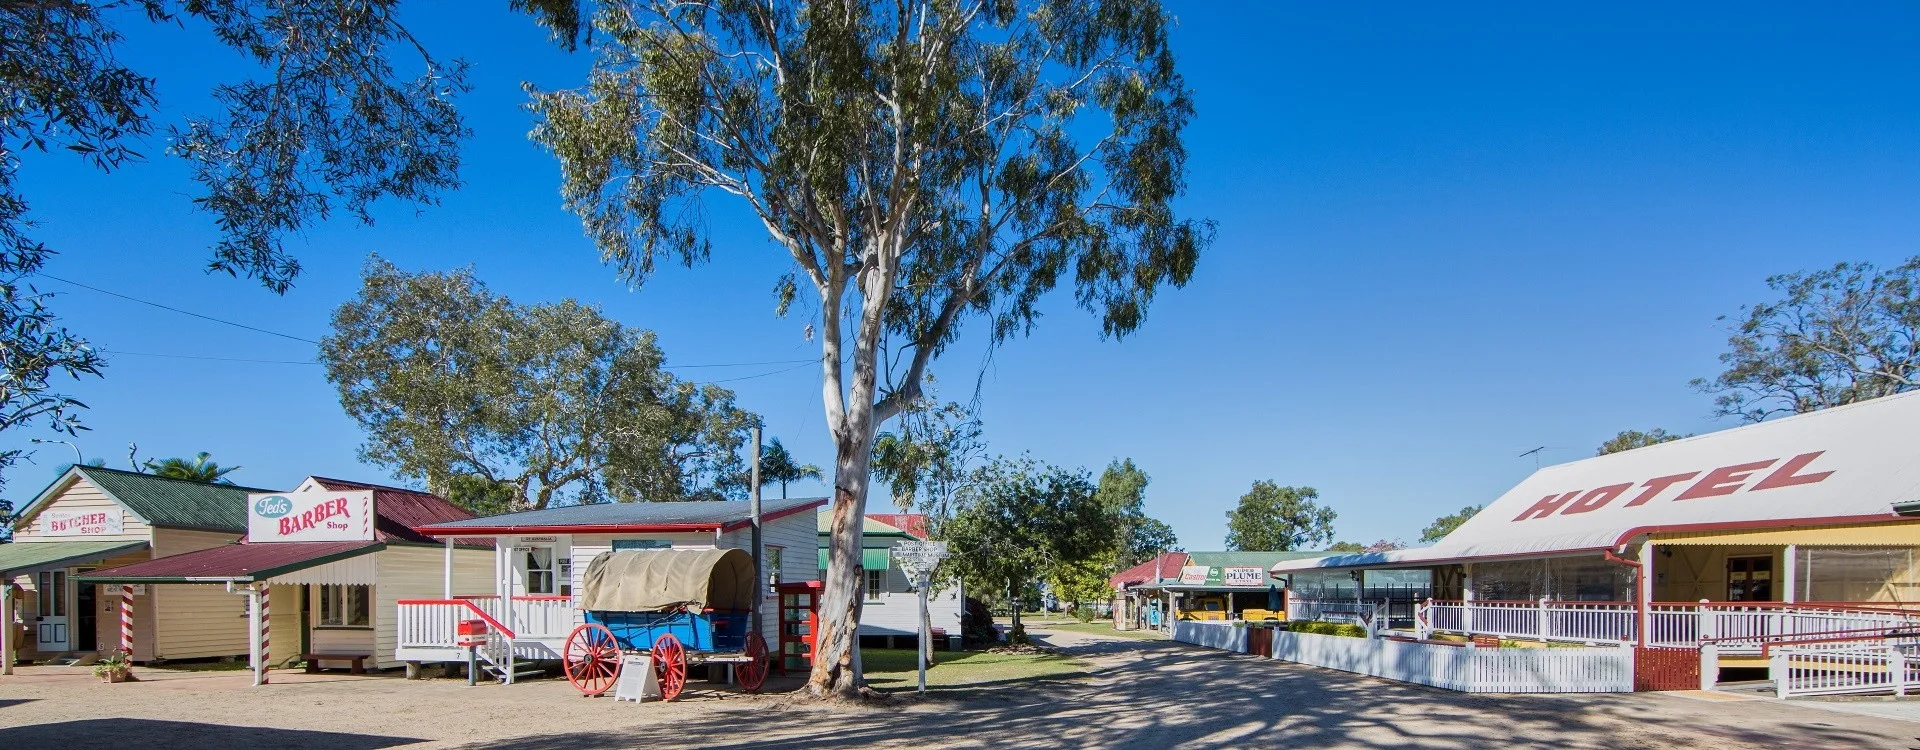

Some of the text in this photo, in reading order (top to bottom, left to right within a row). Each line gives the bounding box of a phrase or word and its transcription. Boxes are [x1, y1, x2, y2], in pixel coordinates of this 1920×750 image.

[1511, 450, 1836, 522] HOTEL
[259, 497, 288, 515] Ted's
[51, 512, 106, 532] BUTCHER
[278, 497, 351, 536] BARBER
[326, 521, 349, 532] Shop
[1226, 572, 1262, 580] PLUME
